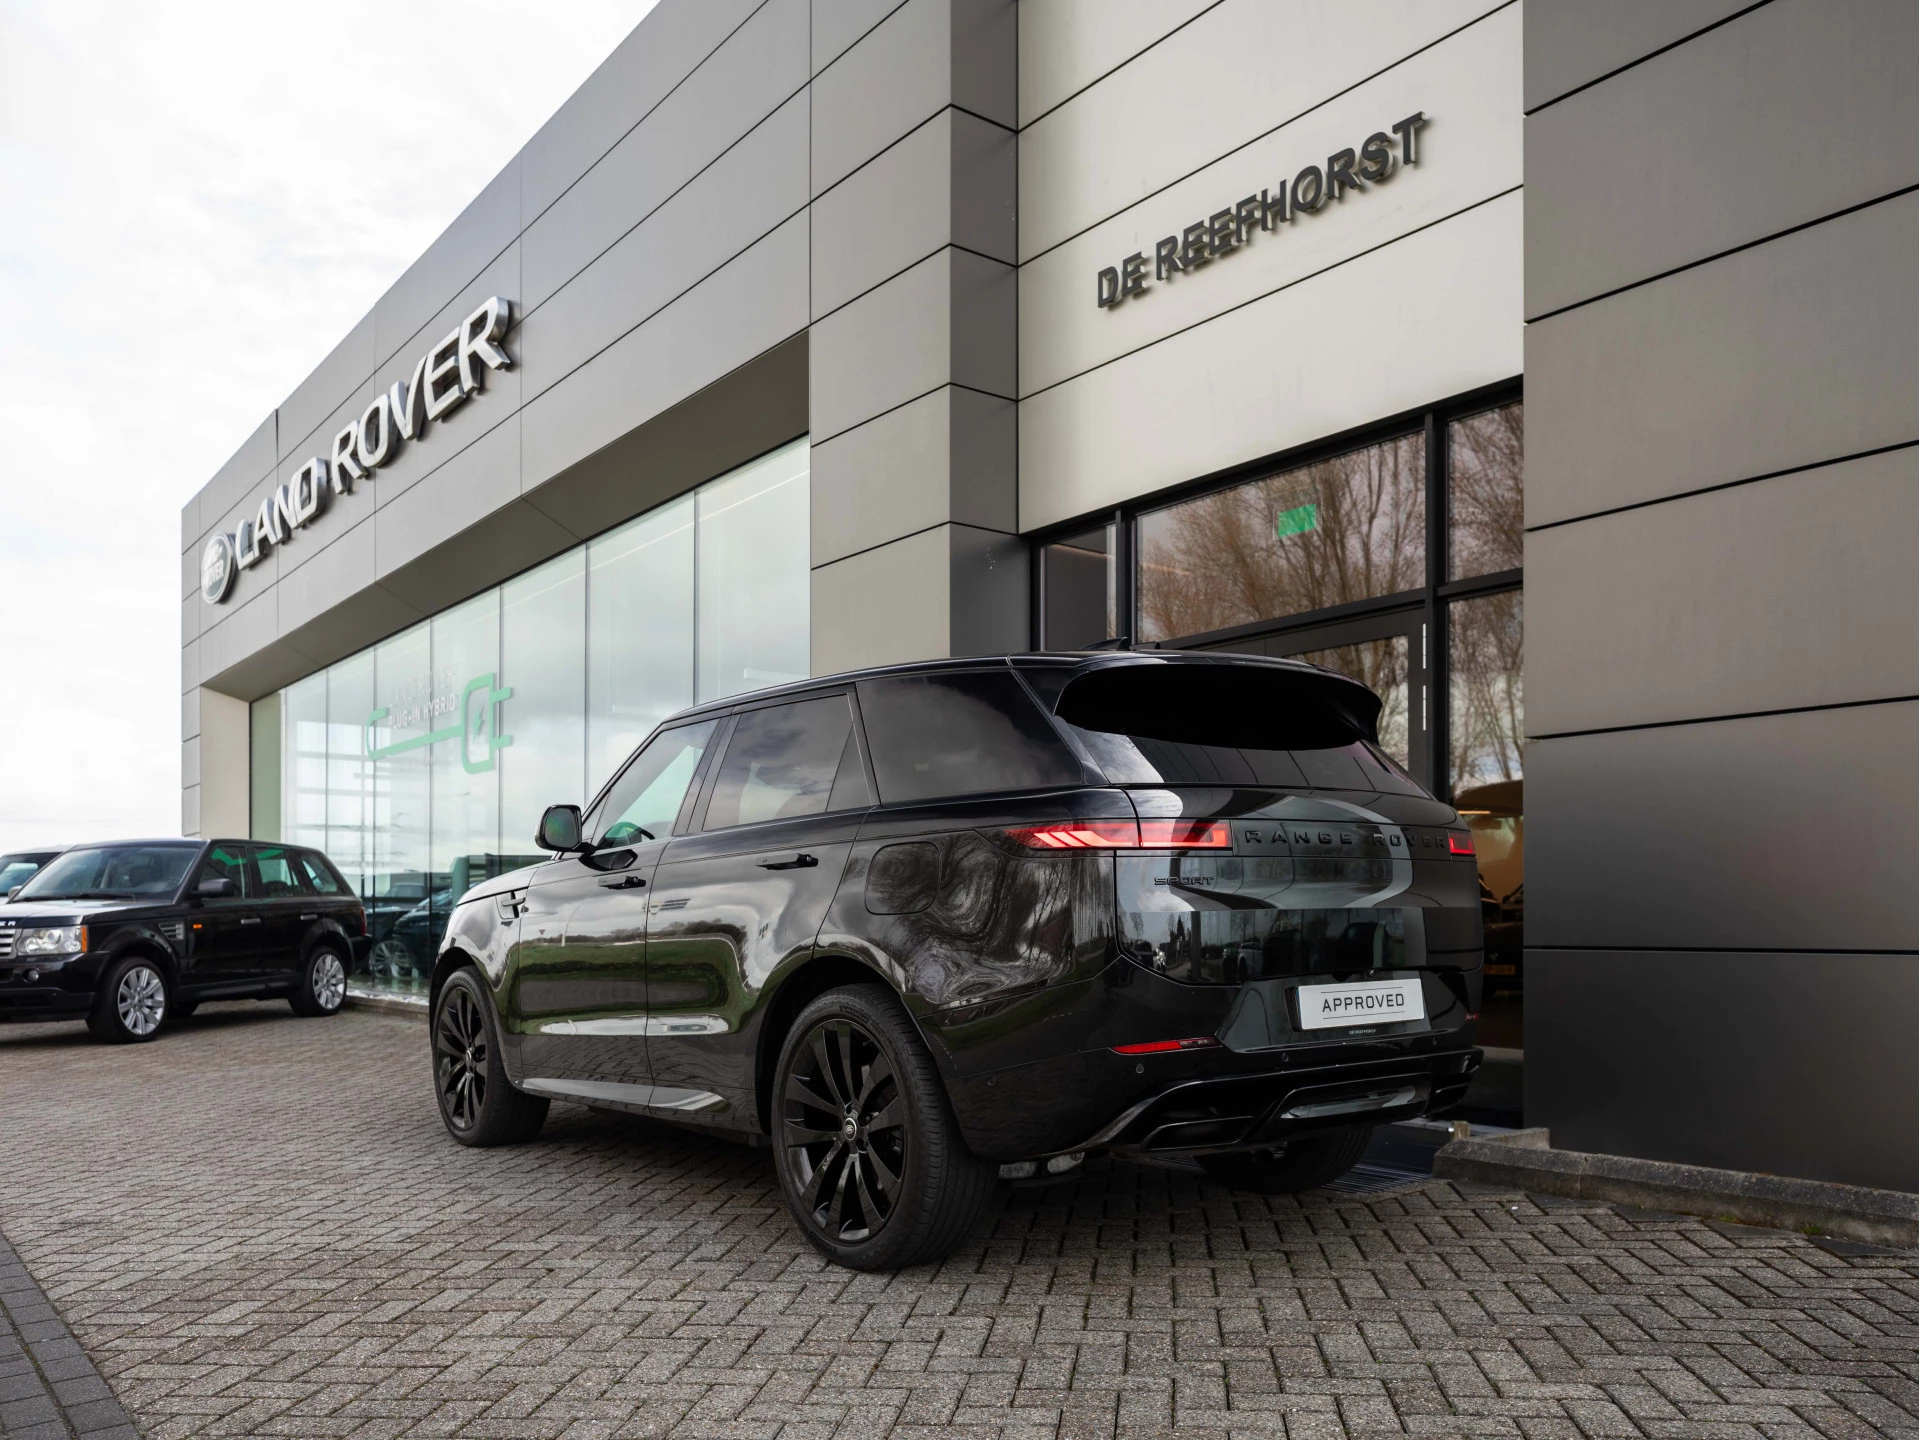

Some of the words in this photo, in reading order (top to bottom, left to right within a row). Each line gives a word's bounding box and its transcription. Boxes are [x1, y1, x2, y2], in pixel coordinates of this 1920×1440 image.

[1097, 251, 1146, 309] DE
[1155, 111, 1427, 281] REEFHORST
[235, 456, 328, 570] LAND
[331, 296, 511, 495] ROVER
[387, 705, 421, 729] PLUG-IN
[423, 693, 456, 720] HYBRID
[1245, 829, 1353, 846] RANGE
[1372, 833, 1445, 850] ROVER
[1154, 876, 1215, 886] SPORT
[1321, 992, 1406, 1014] APPROVED
